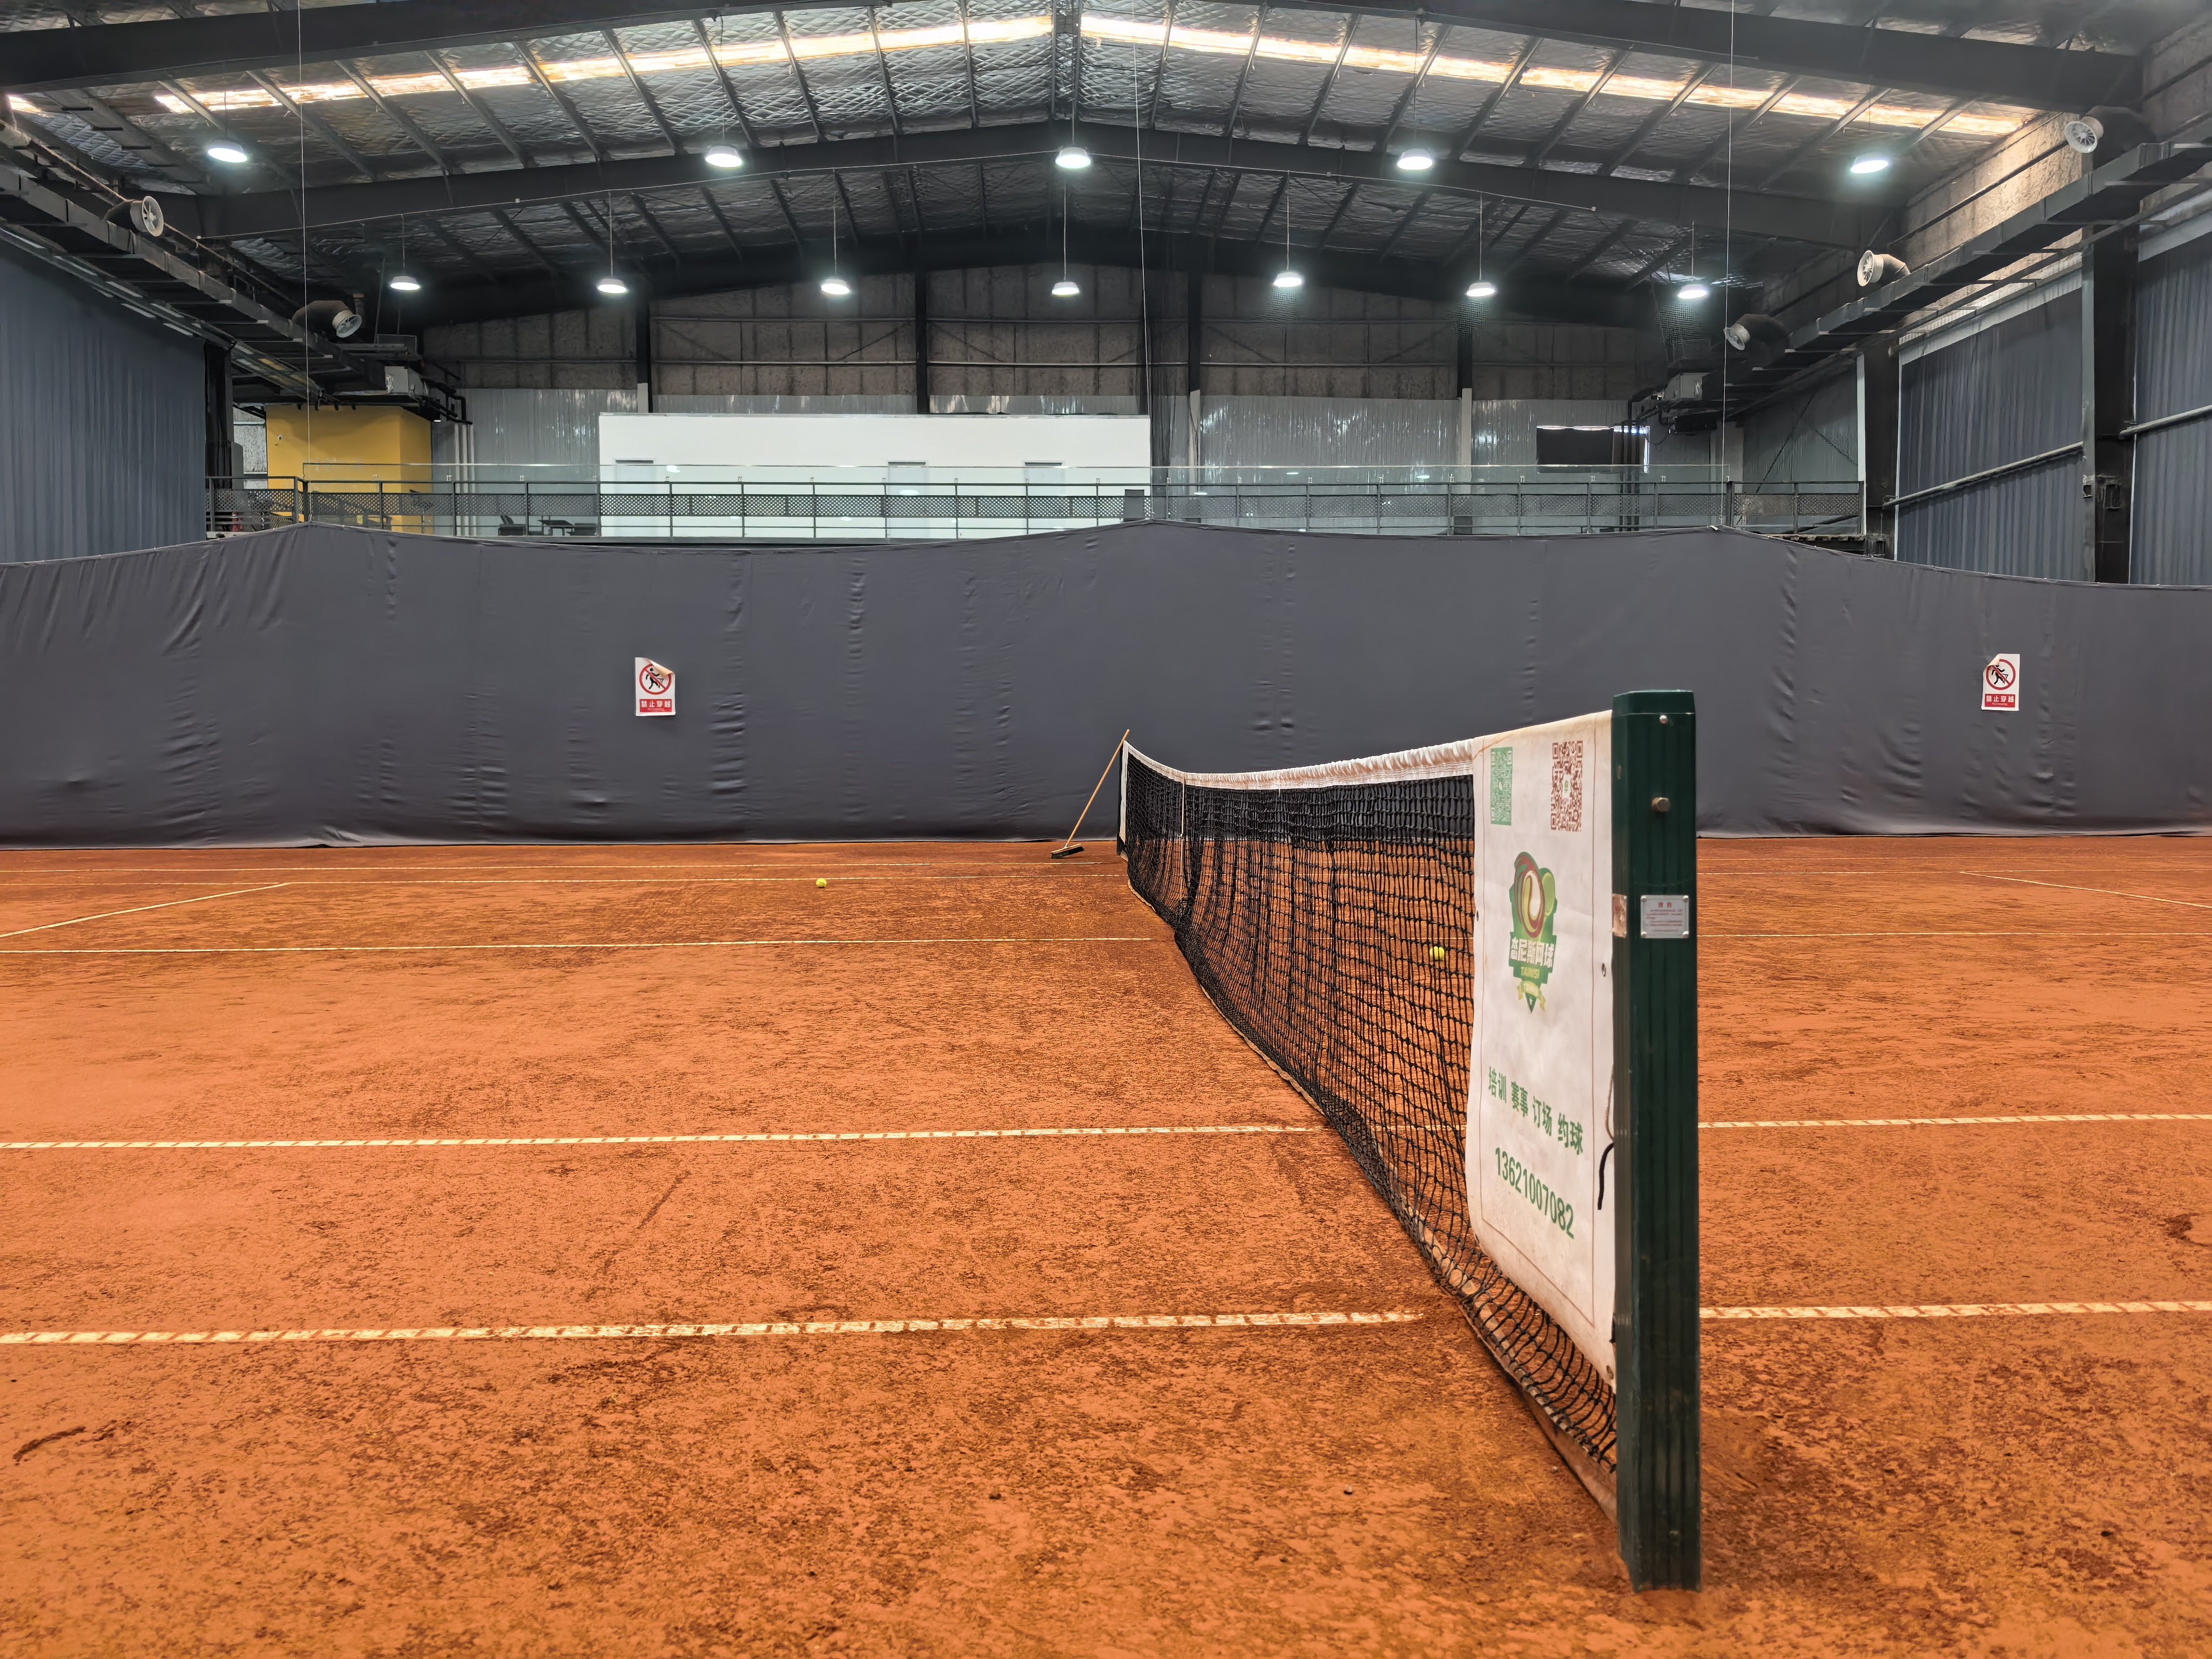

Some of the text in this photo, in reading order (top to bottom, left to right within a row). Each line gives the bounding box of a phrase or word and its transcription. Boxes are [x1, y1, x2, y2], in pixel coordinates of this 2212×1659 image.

[1488, 1066, 1583, 1155] 培训 赛事 订场 约球
[1495, 1147, 1574, 1239] 13621007082
